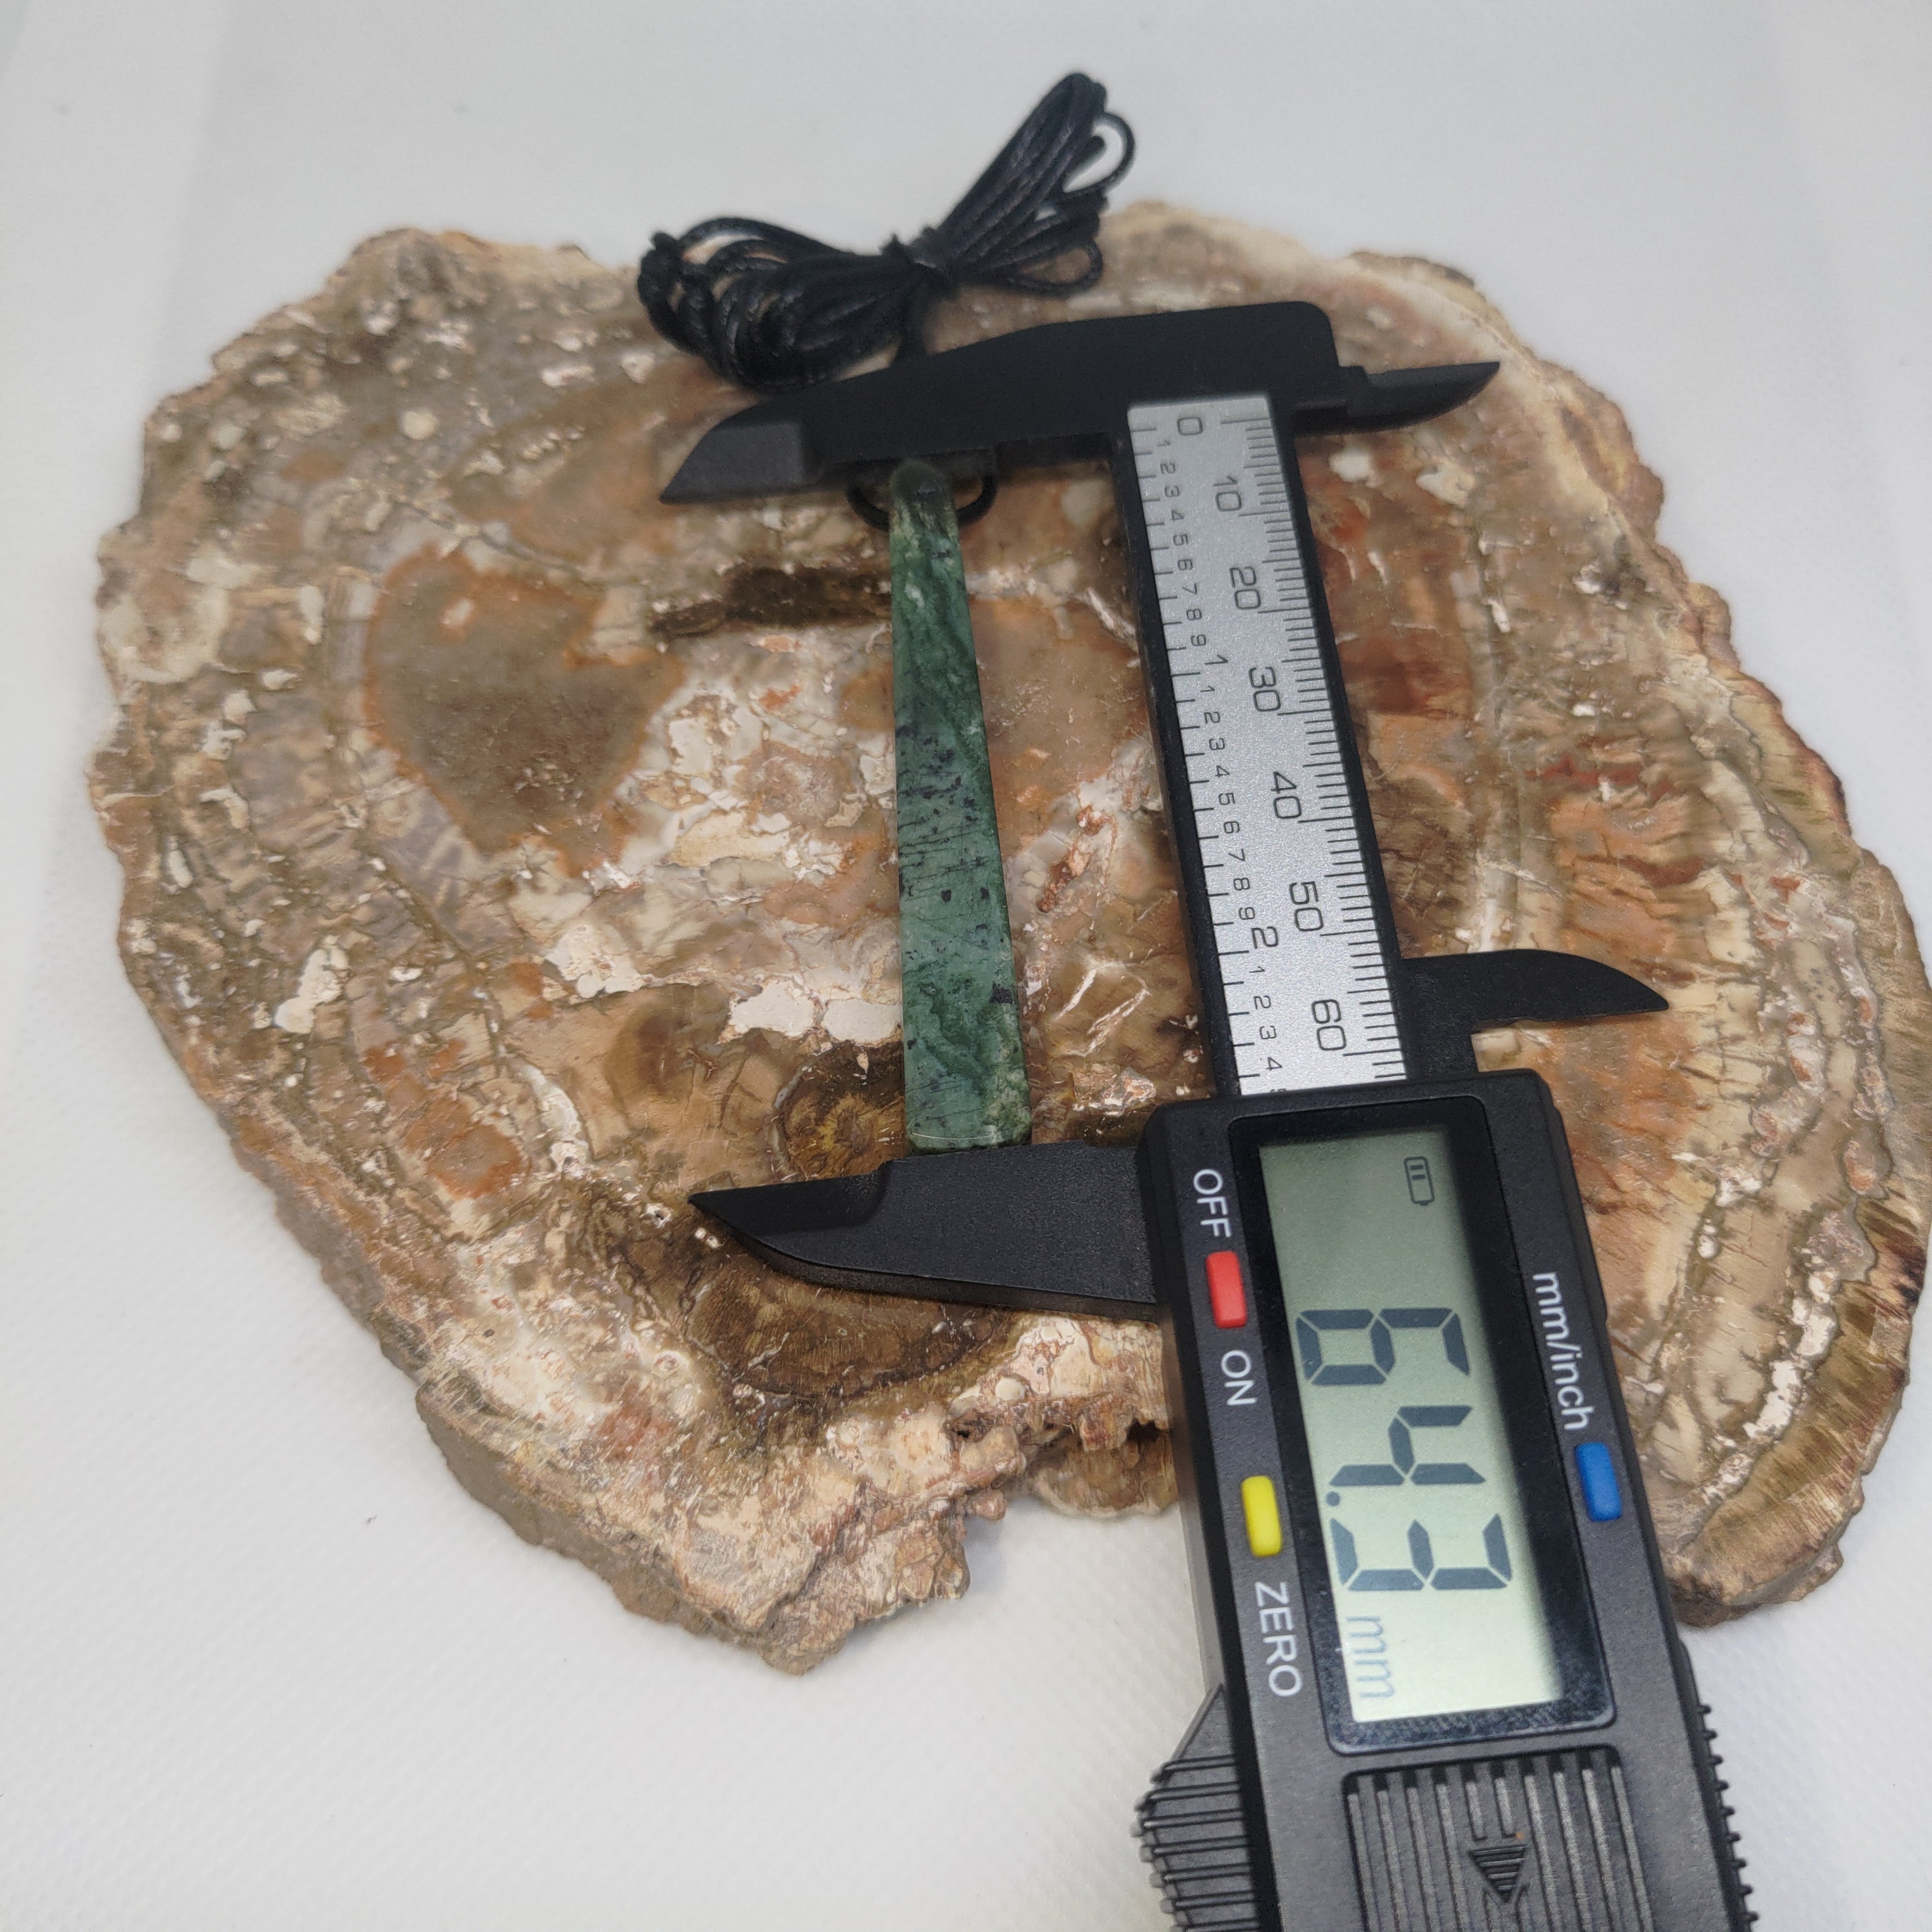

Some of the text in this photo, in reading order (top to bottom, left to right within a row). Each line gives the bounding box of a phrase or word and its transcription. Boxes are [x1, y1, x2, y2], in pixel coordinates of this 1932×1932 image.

[1160, 463, 1175, 473] 2
[1165, 486, 1180, 497] 3
[1171, 510, 1184, 521] 4
[1173, 534, 1188, 545] 5
[1178, 559, 1193, 570] 6
[1183, 583, 1197, 594] 7
[1186, 609, 1202, 620] 8
[1191, 634, 1206, 646] 9
[1205, 655, 1228, 665] 1
[1204, 712, 1220, 723] 2
[1177, 417, 1347, 1051] 0 10 20 30 40 50 60
[1209, 738, 1225, 750] 3
[1215, 766, 1229, 777] 4
[1219, 793, 1235, 805] 5
[1223, 821, 1240, 834] 6
[1228, 849, 1245, 861] 7
[1233, 878, 1250, 891] 8
[1238, 907, 1255, 920] 9
[1251, 926, 1278, 949] 2
[1254, 995, 1271, 1009] 2
[1259, 1026, 1277, 1040] 3
[1266, 1057, 1282, 1071] 4
[1193, 1169, 1231, 1238] OFF
[1532, 1272, 1593, 1430] mm/inch
[1220, 1350, 1255, 1406] ON
[1296, 1307, 1513, 1700] 64.3 mm
[1255, 1582, 1302, 1697] ZERO
